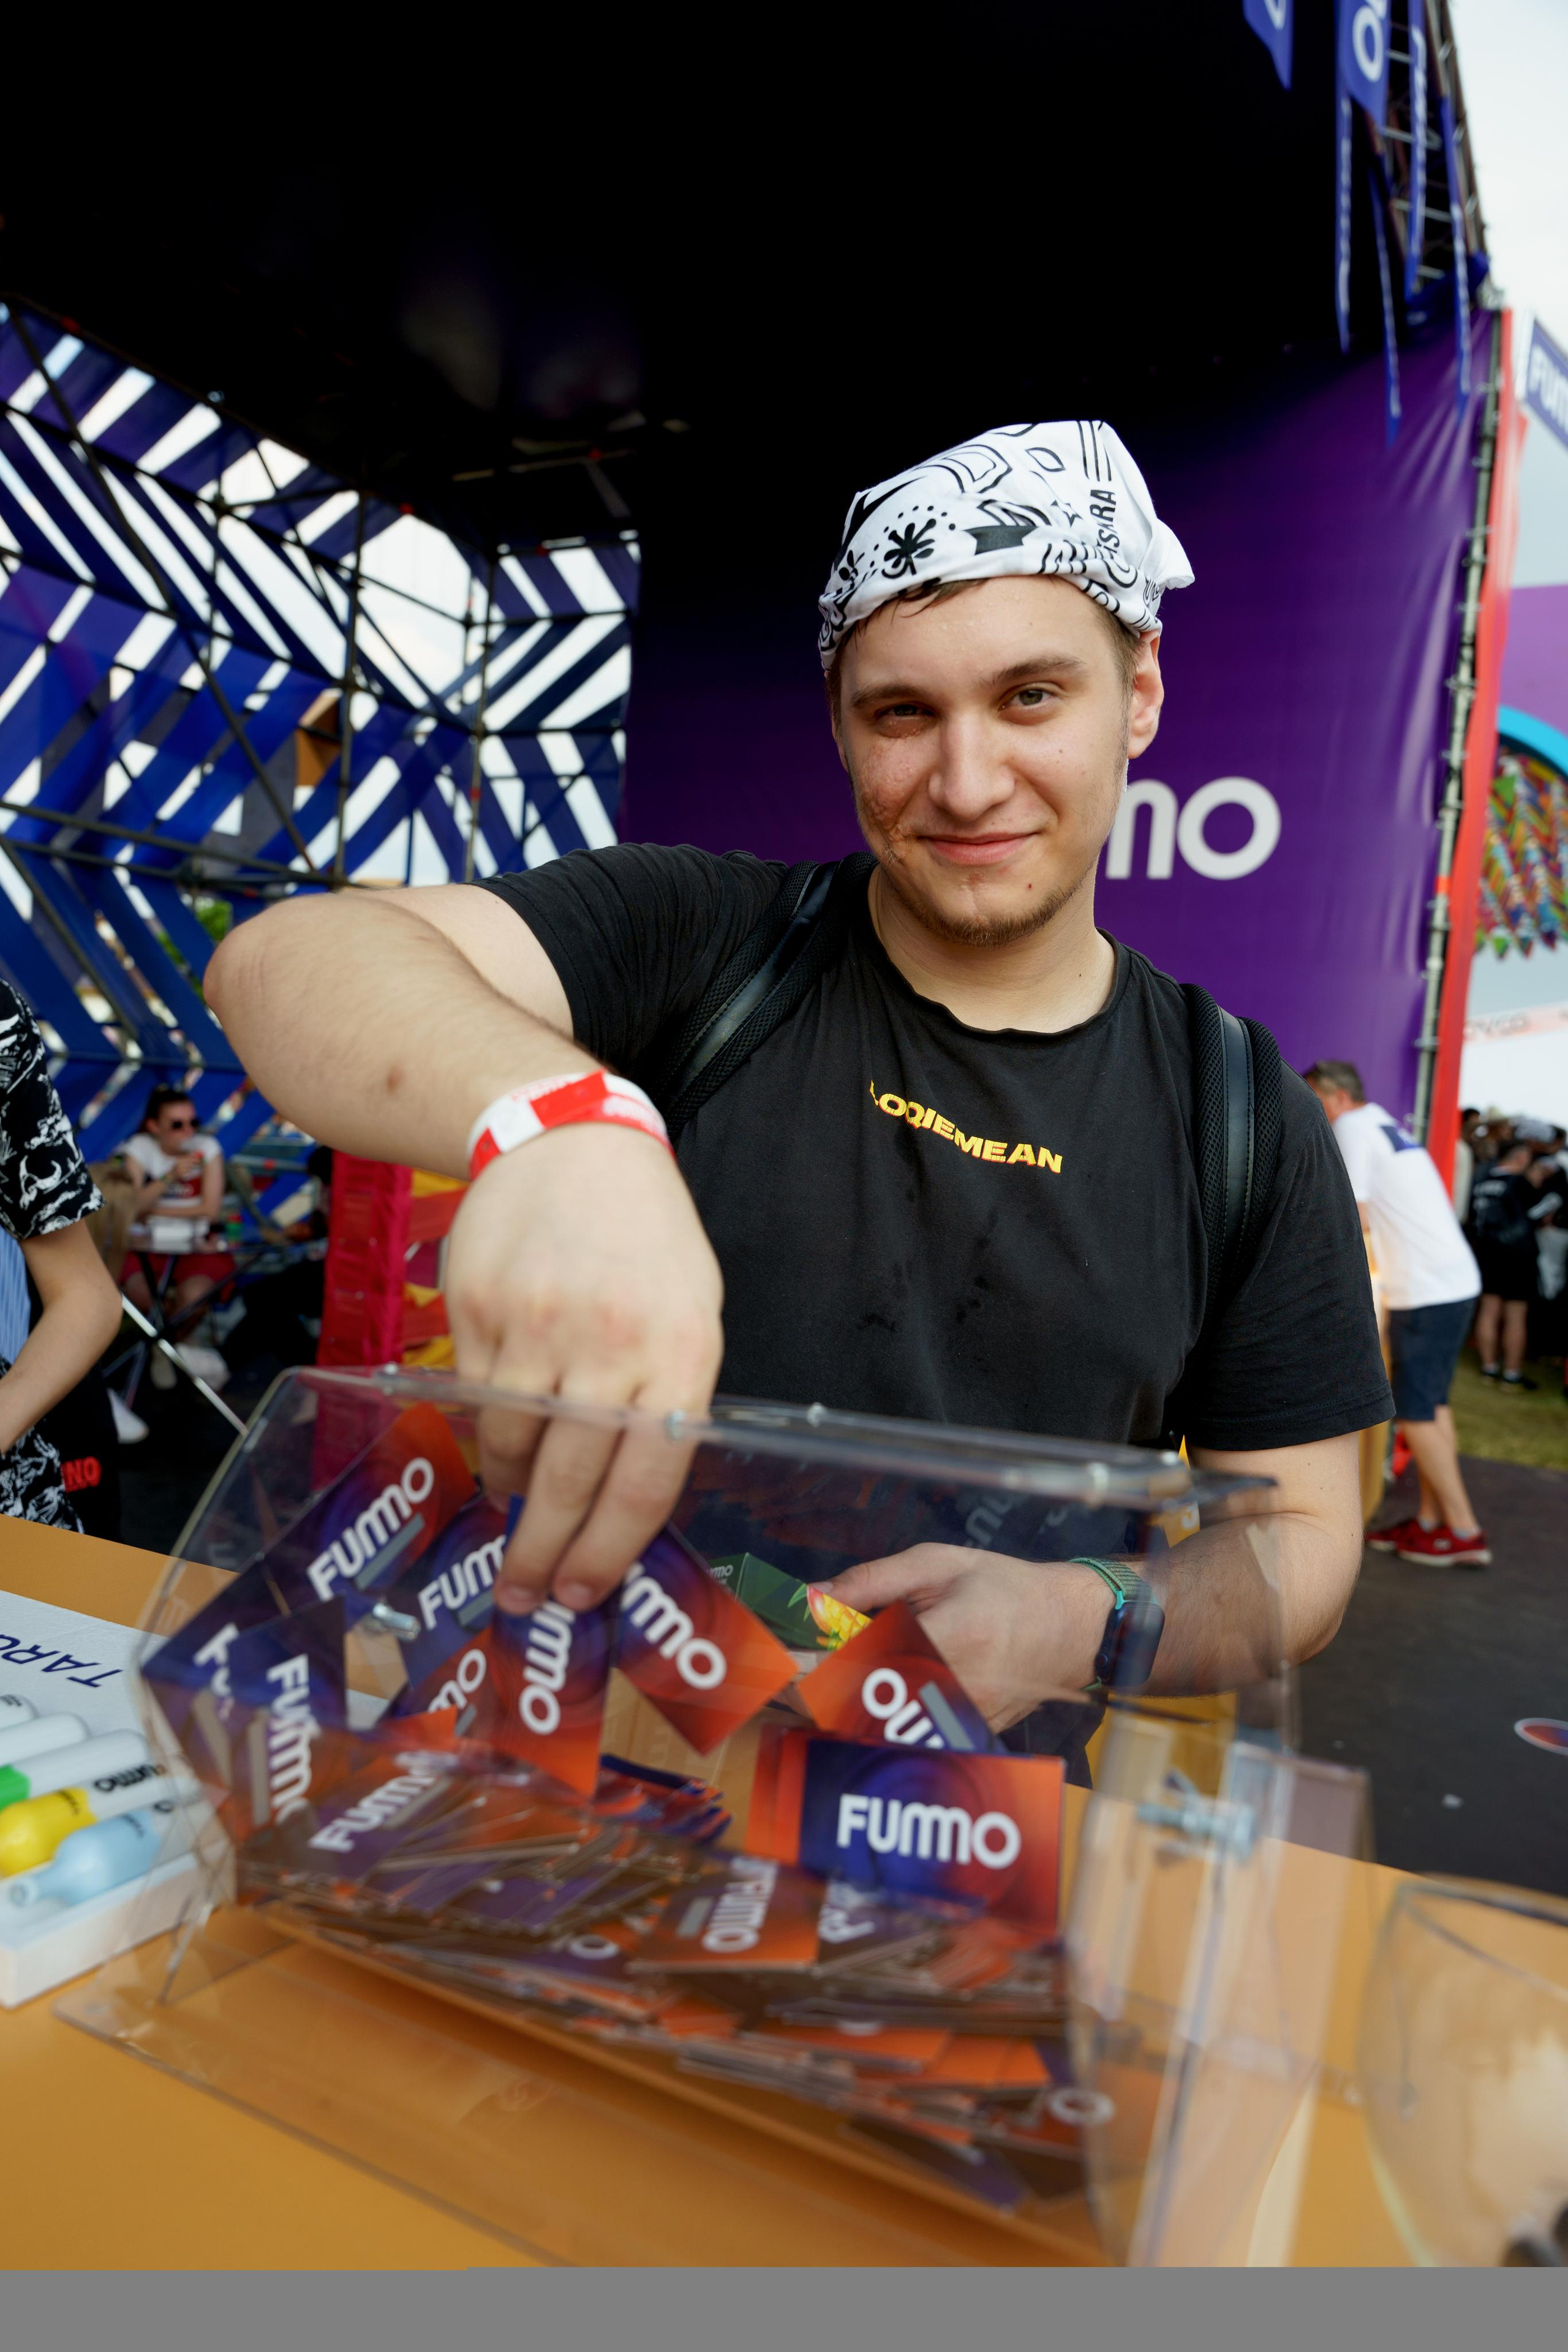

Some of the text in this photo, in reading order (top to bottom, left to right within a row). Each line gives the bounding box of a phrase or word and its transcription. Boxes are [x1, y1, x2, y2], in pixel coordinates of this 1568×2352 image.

[870, 1080, 1063, 1174] OQIEMEAN
[307, 1457, 435, 1601] FUMO
[836, 1792, 1022, 1868] FUMO
